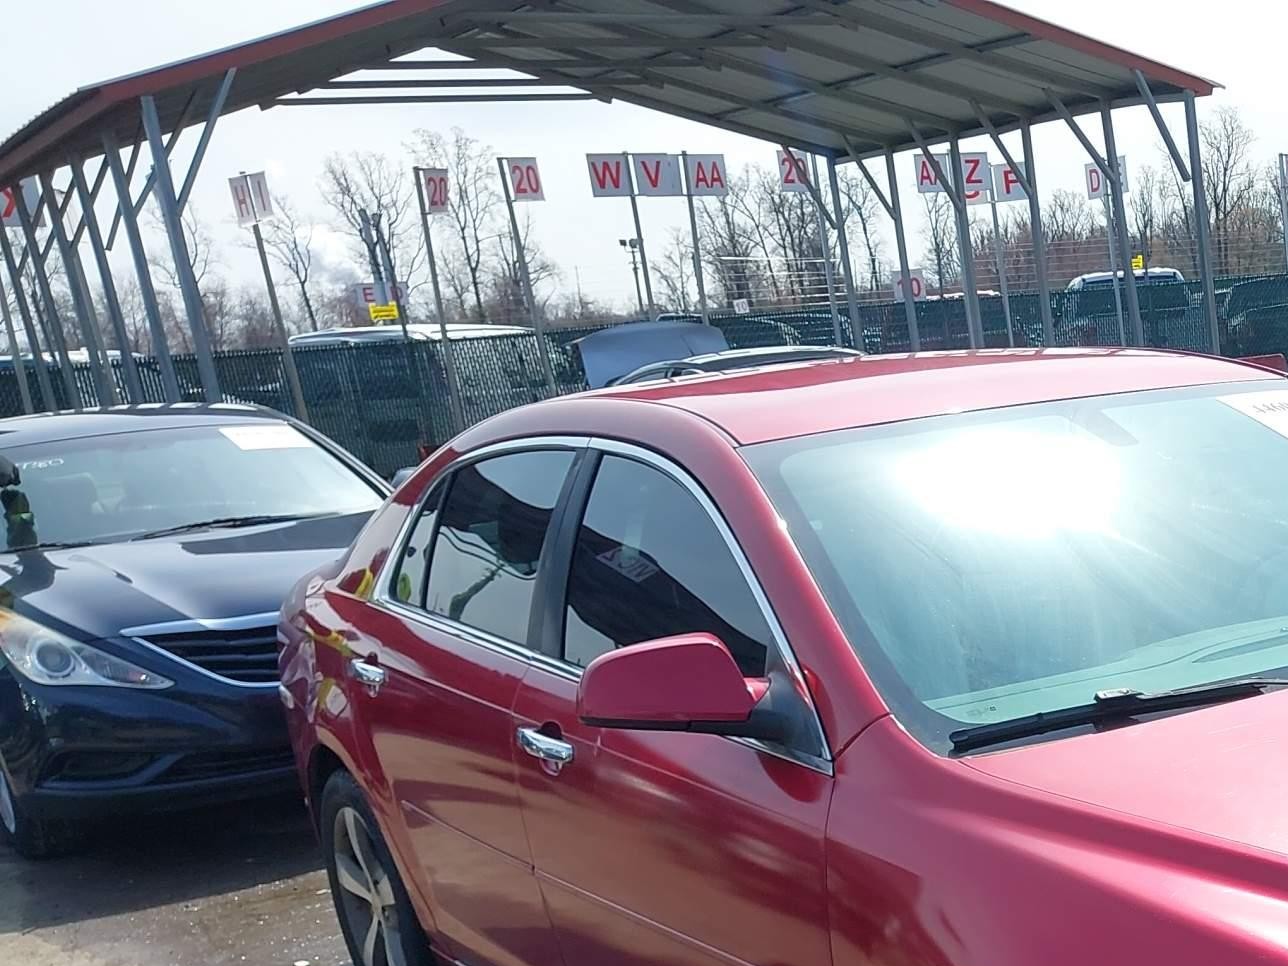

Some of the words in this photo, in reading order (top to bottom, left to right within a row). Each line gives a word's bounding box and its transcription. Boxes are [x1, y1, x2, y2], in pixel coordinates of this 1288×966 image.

[512, 165, 540, 194] 20
[591, 161, 621, 189] W
[641, 160, 661, 188] V
[695, 161, 725, 188] AA
[964, 159, 983, 184] Z
[1089, 168, 1100, 193] D
[428, 176, 448, 206] 20
[362, 287, 376, 302] E
